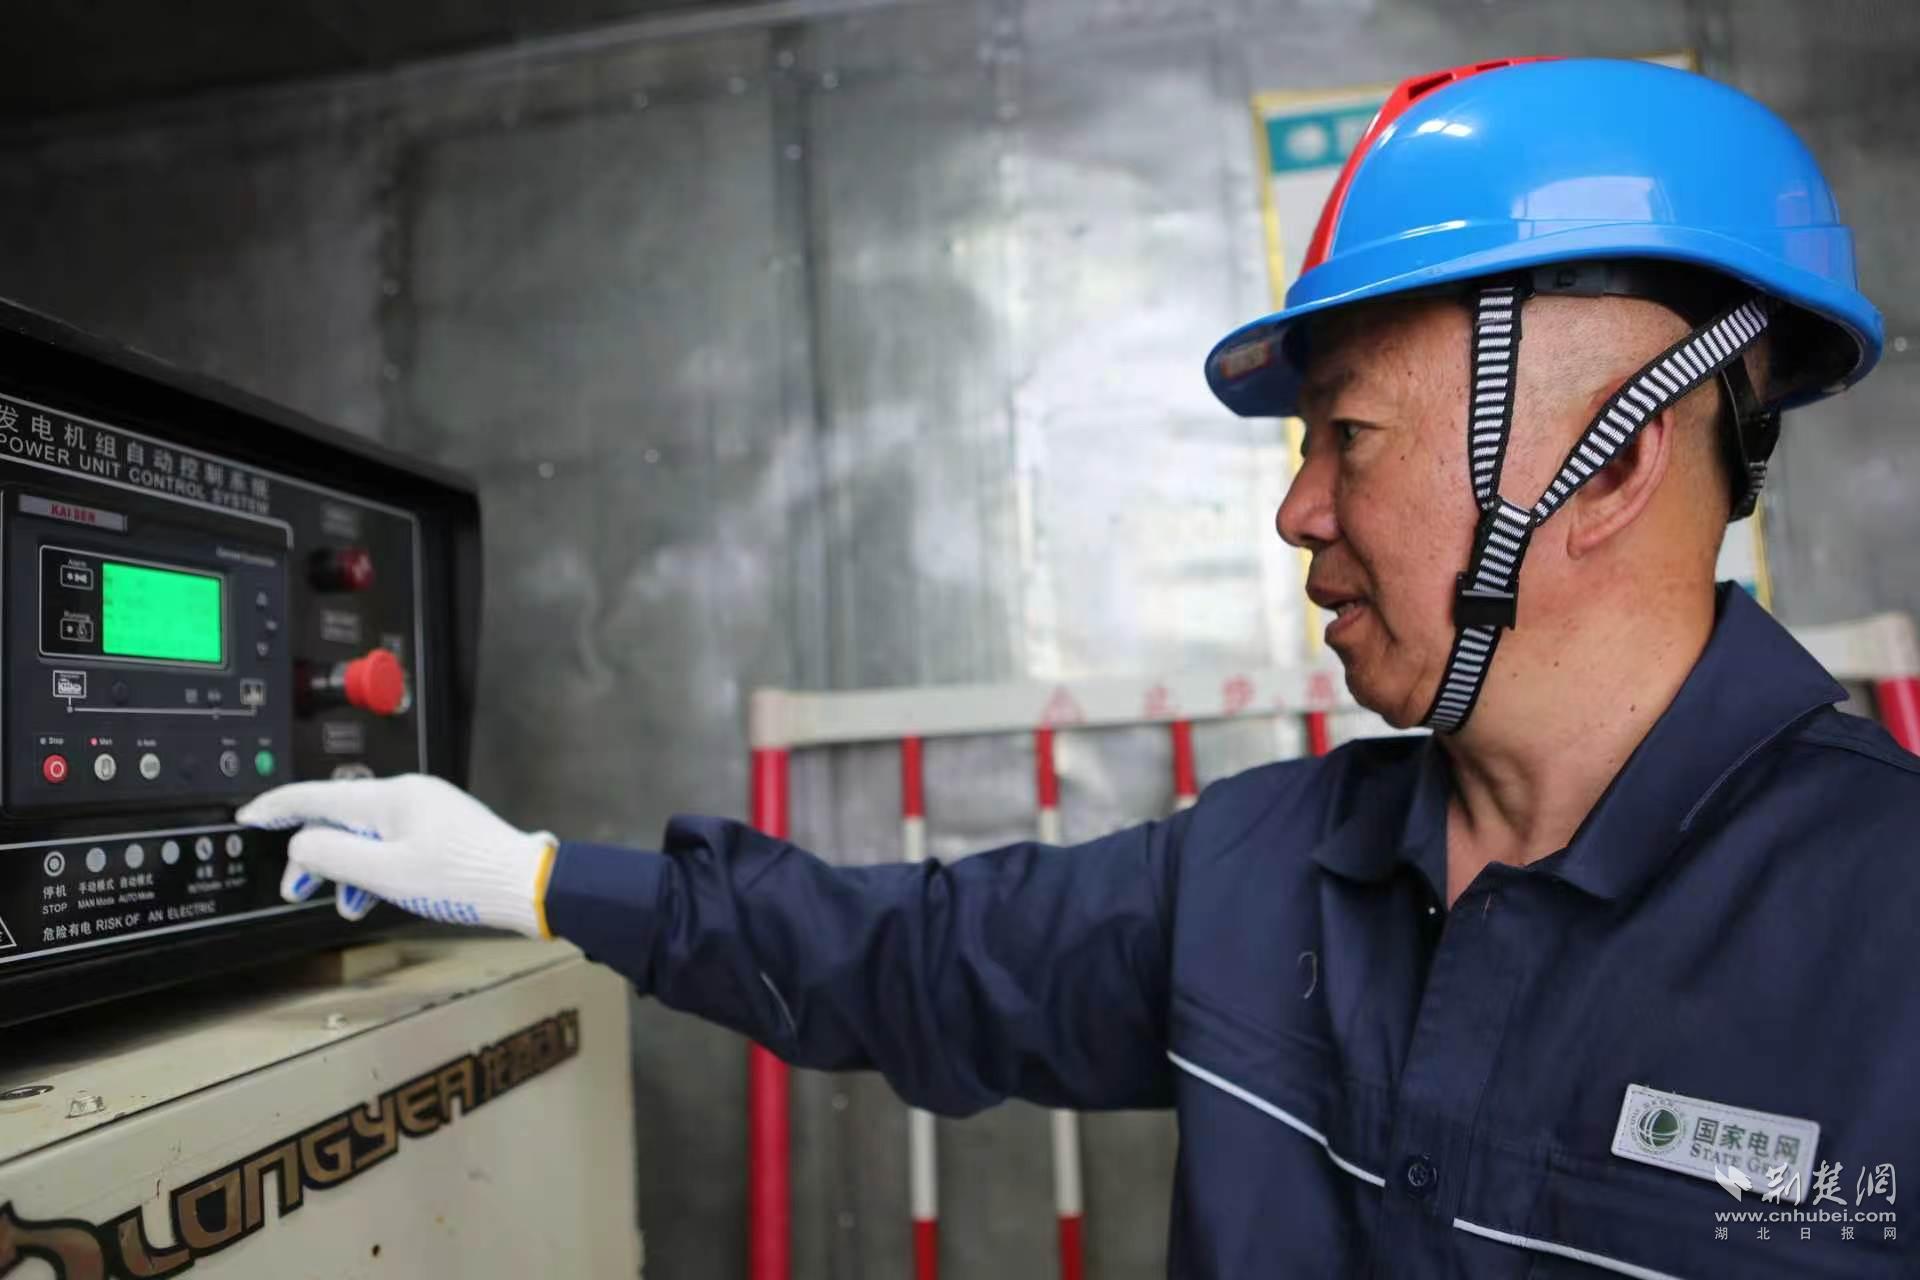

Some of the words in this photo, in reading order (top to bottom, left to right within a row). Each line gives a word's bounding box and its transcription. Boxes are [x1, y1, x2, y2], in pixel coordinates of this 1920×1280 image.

[80, 454, 121, 478] UNIT
[129, 468, 206, 499] CONTROL
[43, 886, 66, 900] 停机
[42, 902, 68, 915] STOP
[96, 915, 122, 931] RISK
[125, 912, 140, 927] OF
[148, 907, 164, 922] AN
[167, 901, 216, 920] ELECTRIC
[43, 922, 91, 942] 危险有电
[1693, 1117, 1801, 1164] 国家电网
[1690, 1142, 1742, 1168] STATE
